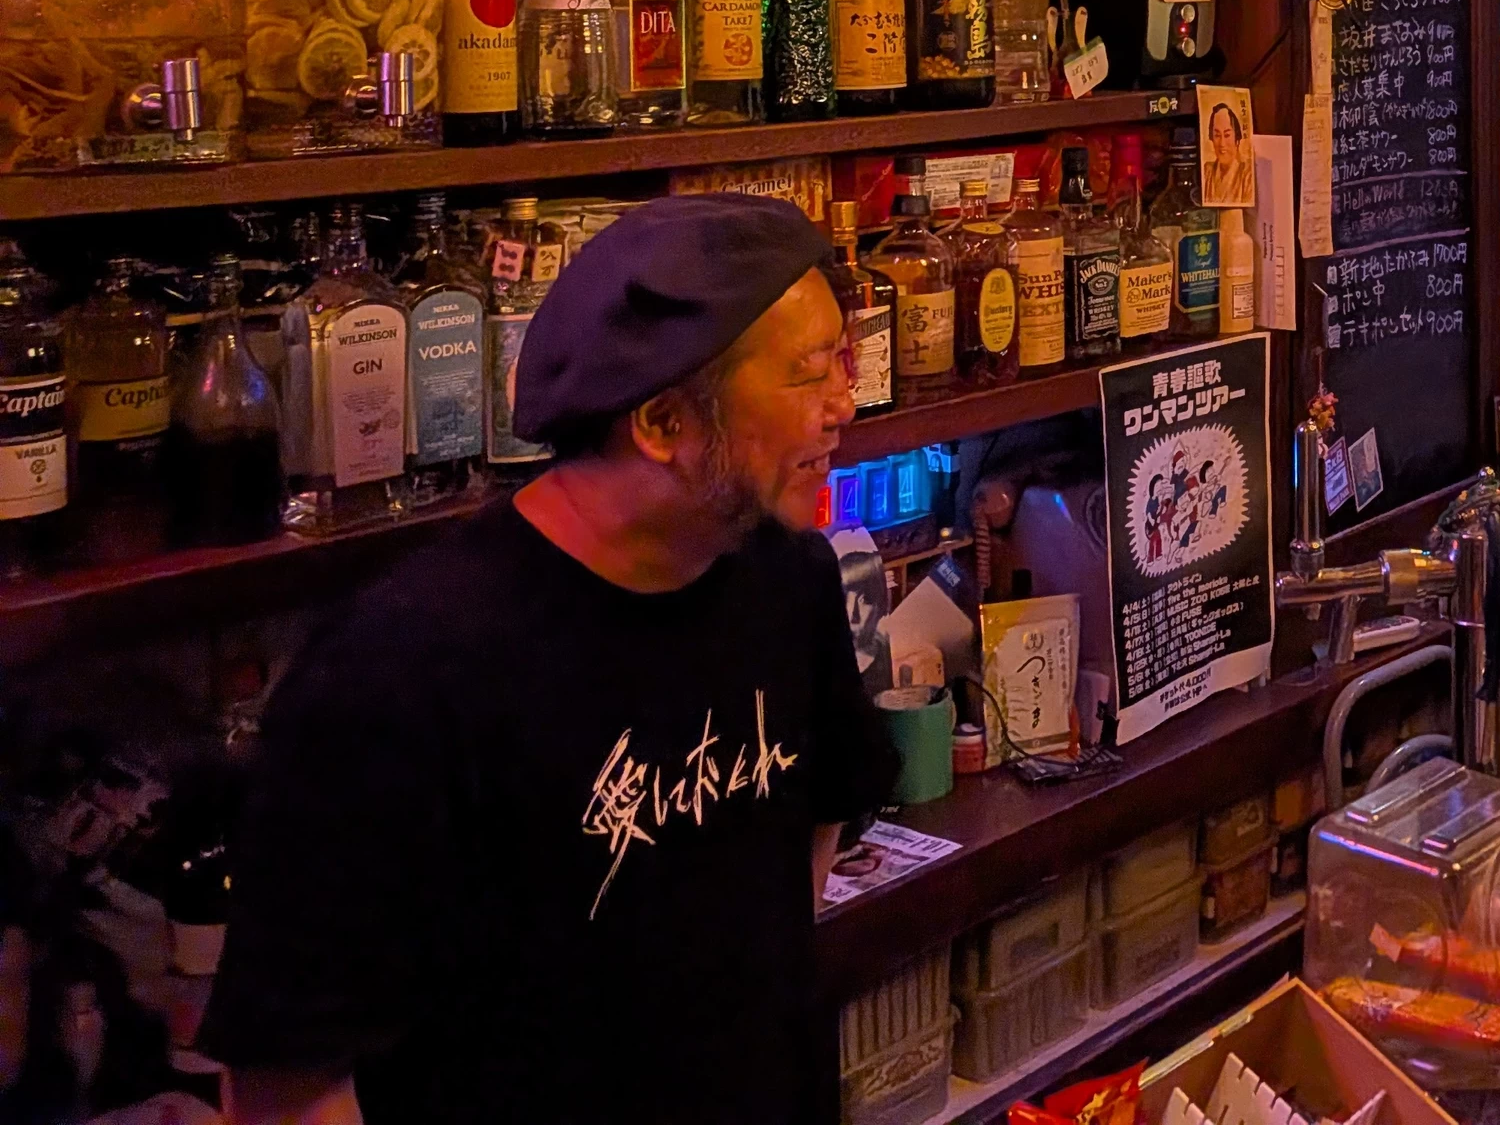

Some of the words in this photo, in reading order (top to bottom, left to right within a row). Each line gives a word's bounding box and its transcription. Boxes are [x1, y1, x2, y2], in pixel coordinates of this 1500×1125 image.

[640, 10, 676, 34] DITA
[486, 71, 512, 82] 1907
[1079, 266, 1096, 284] JACK
[1127, 271, 1173, 288] Maker's
[1141, 284, 1171, 300] Mark
[1426, 273, 1464, 299] 800円
[418, 313, 476, 331] WILKINSON
[1425, 309, 1464, 337] 900円
[338, 328, 398, 347] WILKINSON
[901, 303, 930, 366] 富士
[418, 340, 478, 361] VODKA
[352, 358, 383, 375] GIN
[1152, 358, 1223, 399] 青春謳歌
[1123, 385, 1246, 436] ワンマンツアー
